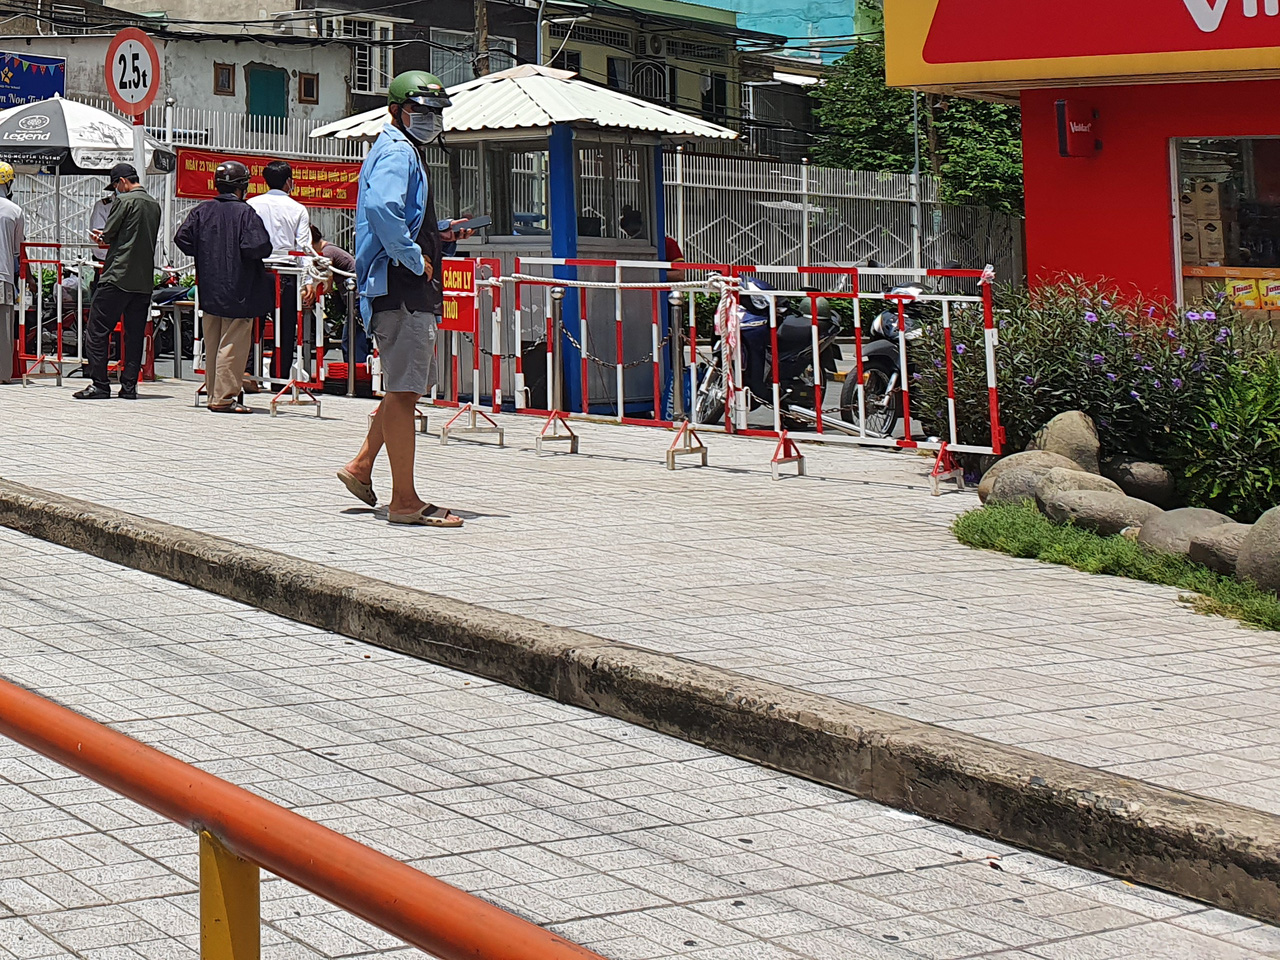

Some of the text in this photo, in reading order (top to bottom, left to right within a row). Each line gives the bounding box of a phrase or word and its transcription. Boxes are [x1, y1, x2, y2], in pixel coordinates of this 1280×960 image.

[118, 53, 148, 89] 2.5t
[8, 92, 26, 105] Non
[3, 131, 51, 141] Legend
[443, 266, 472, 290] CÁCH LY
